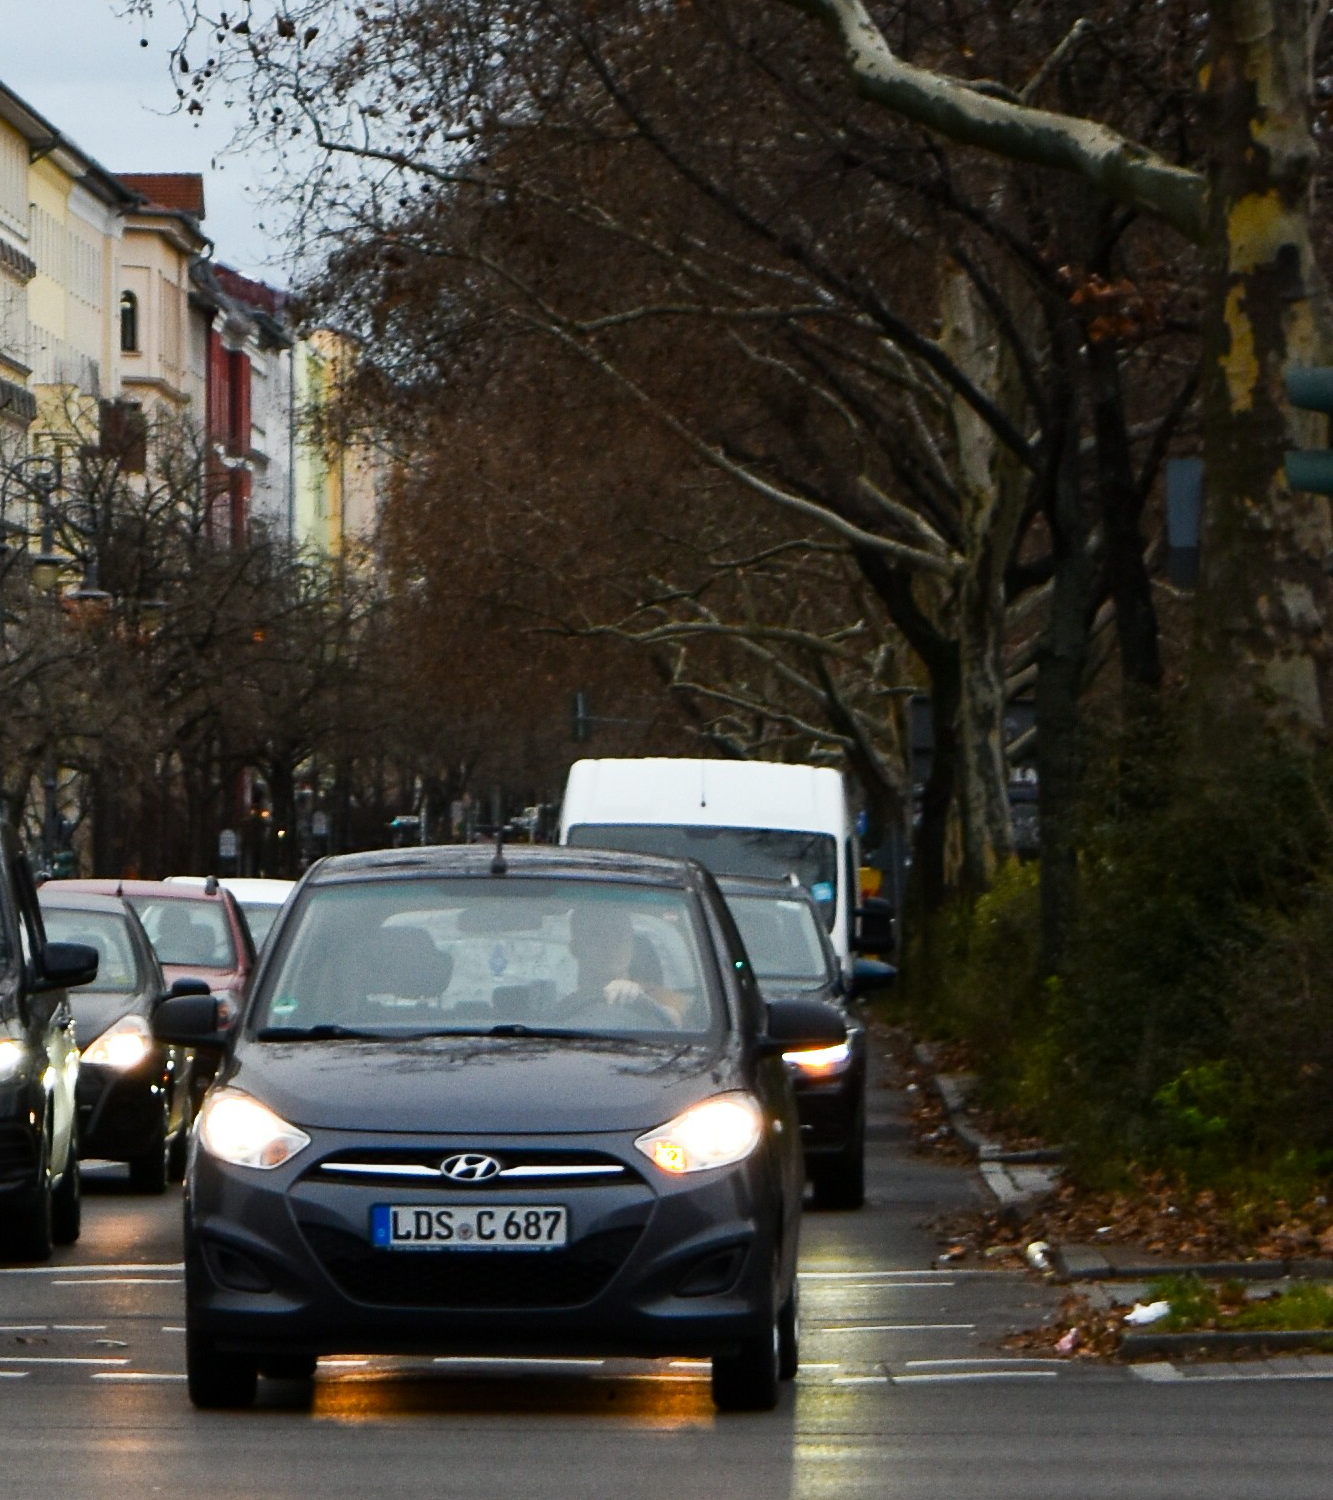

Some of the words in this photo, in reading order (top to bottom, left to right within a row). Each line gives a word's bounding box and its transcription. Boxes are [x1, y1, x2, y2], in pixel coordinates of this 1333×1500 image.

[392, 1210, 454, 1240] LDS
[476, 1210, 496, 1240] C
[503, 1210, 562, 1240] 687
